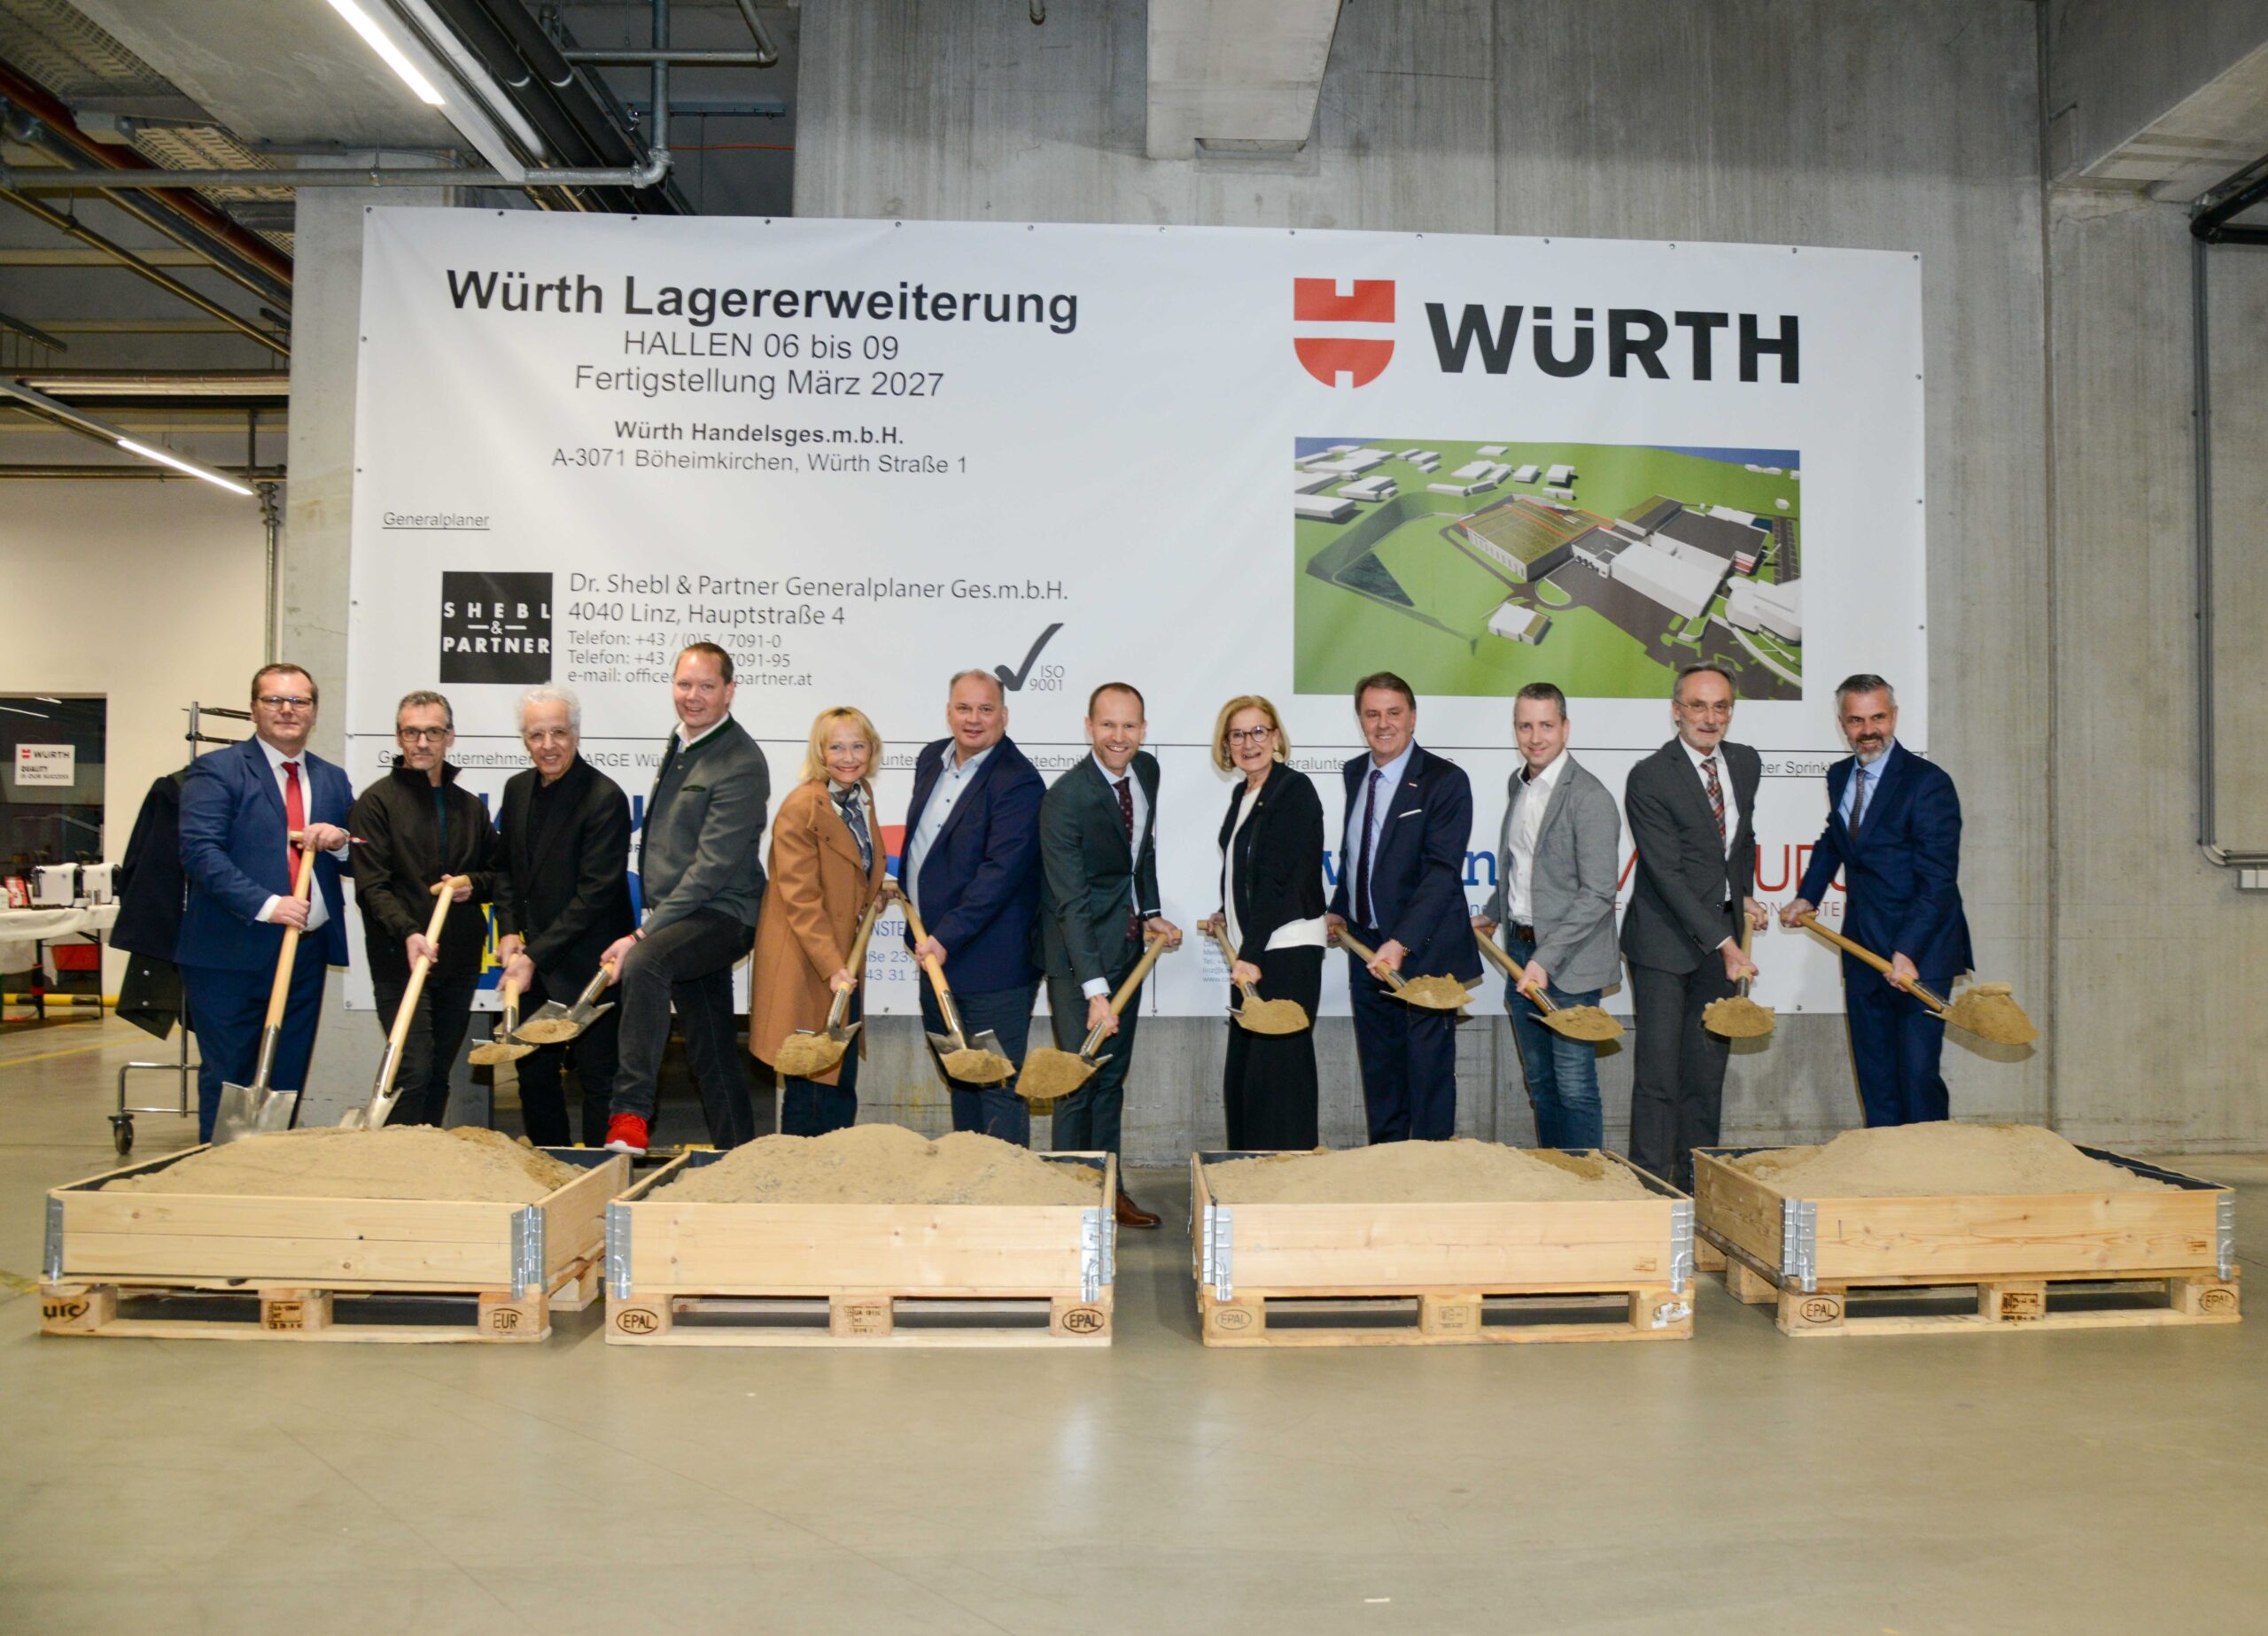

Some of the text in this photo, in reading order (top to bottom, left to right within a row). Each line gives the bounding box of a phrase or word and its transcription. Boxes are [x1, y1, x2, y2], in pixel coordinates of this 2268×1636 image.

[447, 268, 1078, 334] Würth Lagererweiterung
[624, 330, 899, 361] HALLEN 06 bis 09
[1424, 301, 1801, 384] WÜRTH
[576, 364, 944, 400] Fertigstellung März 2027
[614, 420, 904, 446] Würth Handelsges.m.b.H.
[552, 447, 967, 474] A-3071 Böheimkirchen, Würth Straße 1
[383, 511, 490, 528] Generalplaner
[570, 572, 1068, 602] Dr. Shebl & Partner Generalplaner Ges.m.b.H.
[568, 601, 845, 629] 4040 Linz, Hauptstraße 4
[490, 620, 503, 635] &
[442, 636, 551, 654] PARTNER
[567, 630, 631, 646] Telefon:
[635, 632, 665, 647] +43
[727, 633, 781, 648] 7091-0
[567, 648, 630, 664] Telefon:
[634, 651, 665, 665] +43
[567, 667, 620, 683] e-mail:
[1040, 664, 1065, 678] ISO
[1029, 678, 1063, 691] 9001
[1806, 1304, 1837, 1318] EPAL
[493, 1313, 519, 1330] EUR
[623, 1314, 654, 1330] EPAL
[1069, 1314, 1100, 1328] EPAL
